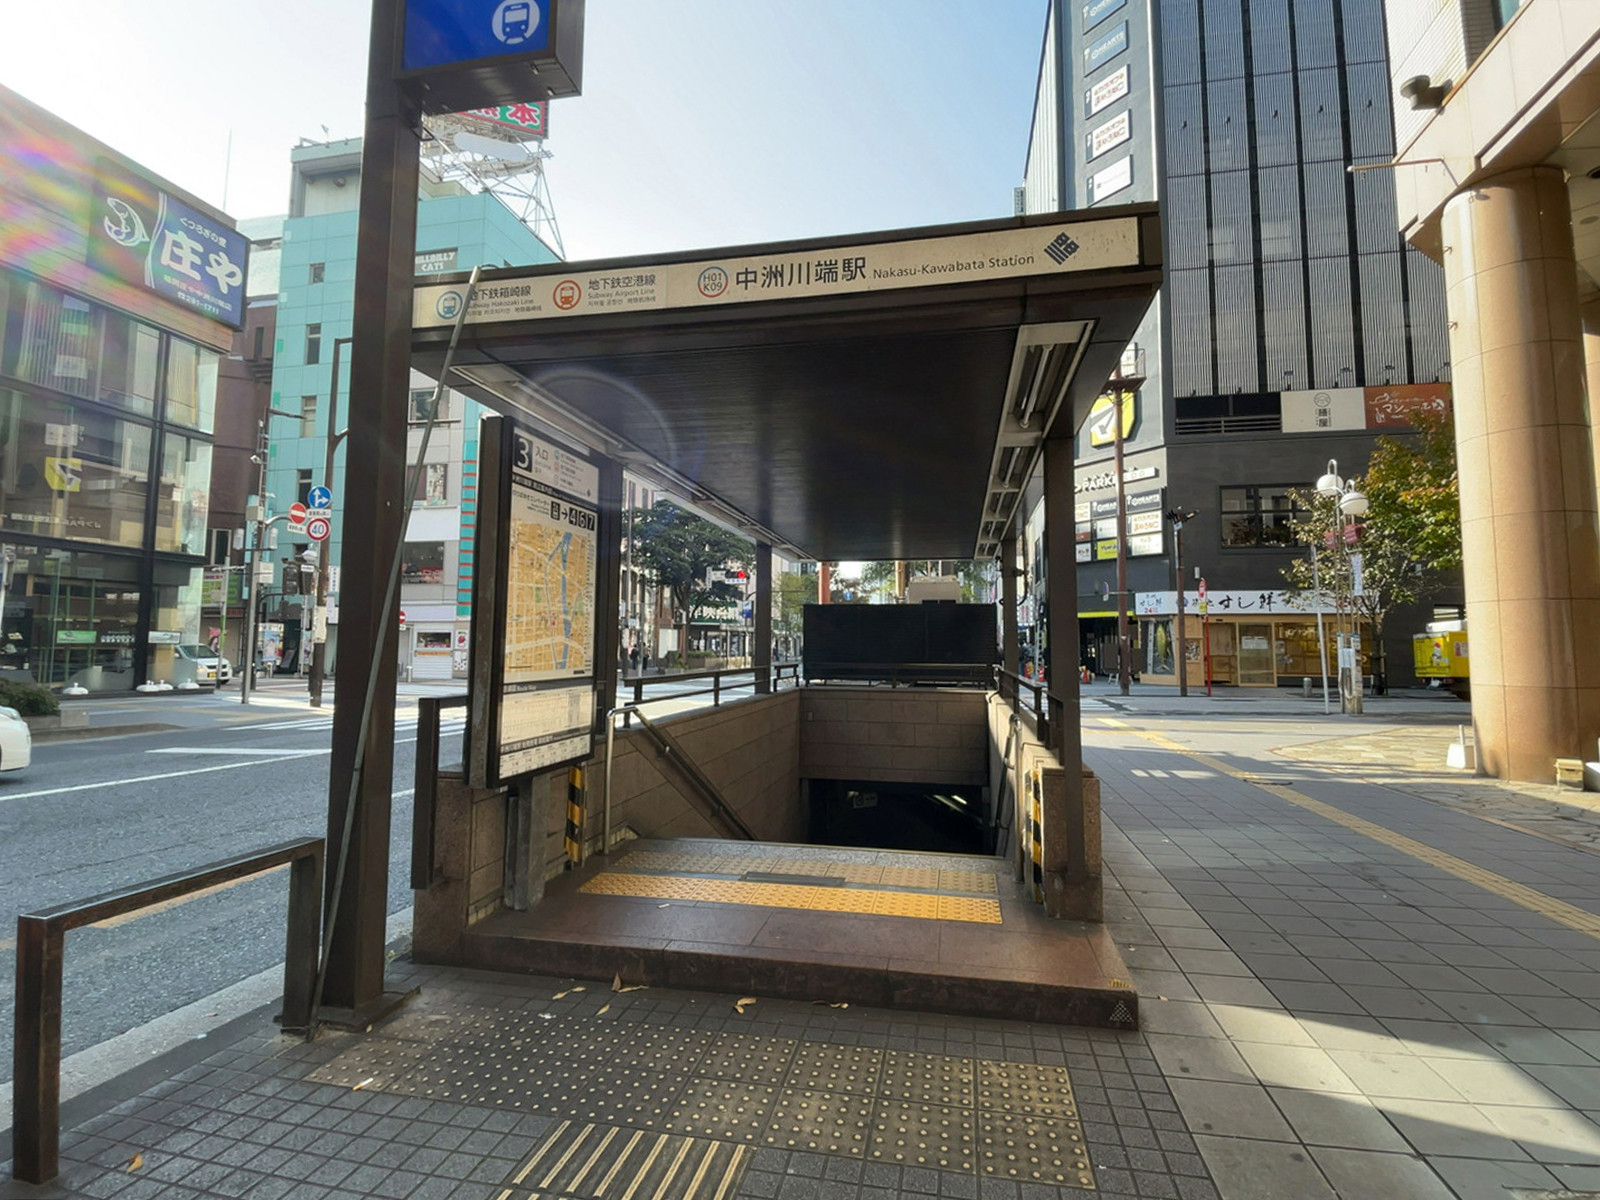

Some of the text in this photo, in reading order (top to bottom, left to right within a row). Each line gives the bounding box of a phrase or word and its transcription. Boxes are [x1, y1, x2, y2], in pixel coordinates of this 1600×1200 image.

[161, 229, 243, 294] 庄や
[872, 252, 1035, 279] Nakasu-Kawabata Station
[588, 274, 656, 290] 地下鉄空港線
[703, 272, 722, 282] H01
[735, 255, 867, 290] 中洲川端駅
[703, 282, 723, 292] K09
[517, 438, 530, 468] 3
[311, 524, 325, 535] 40
